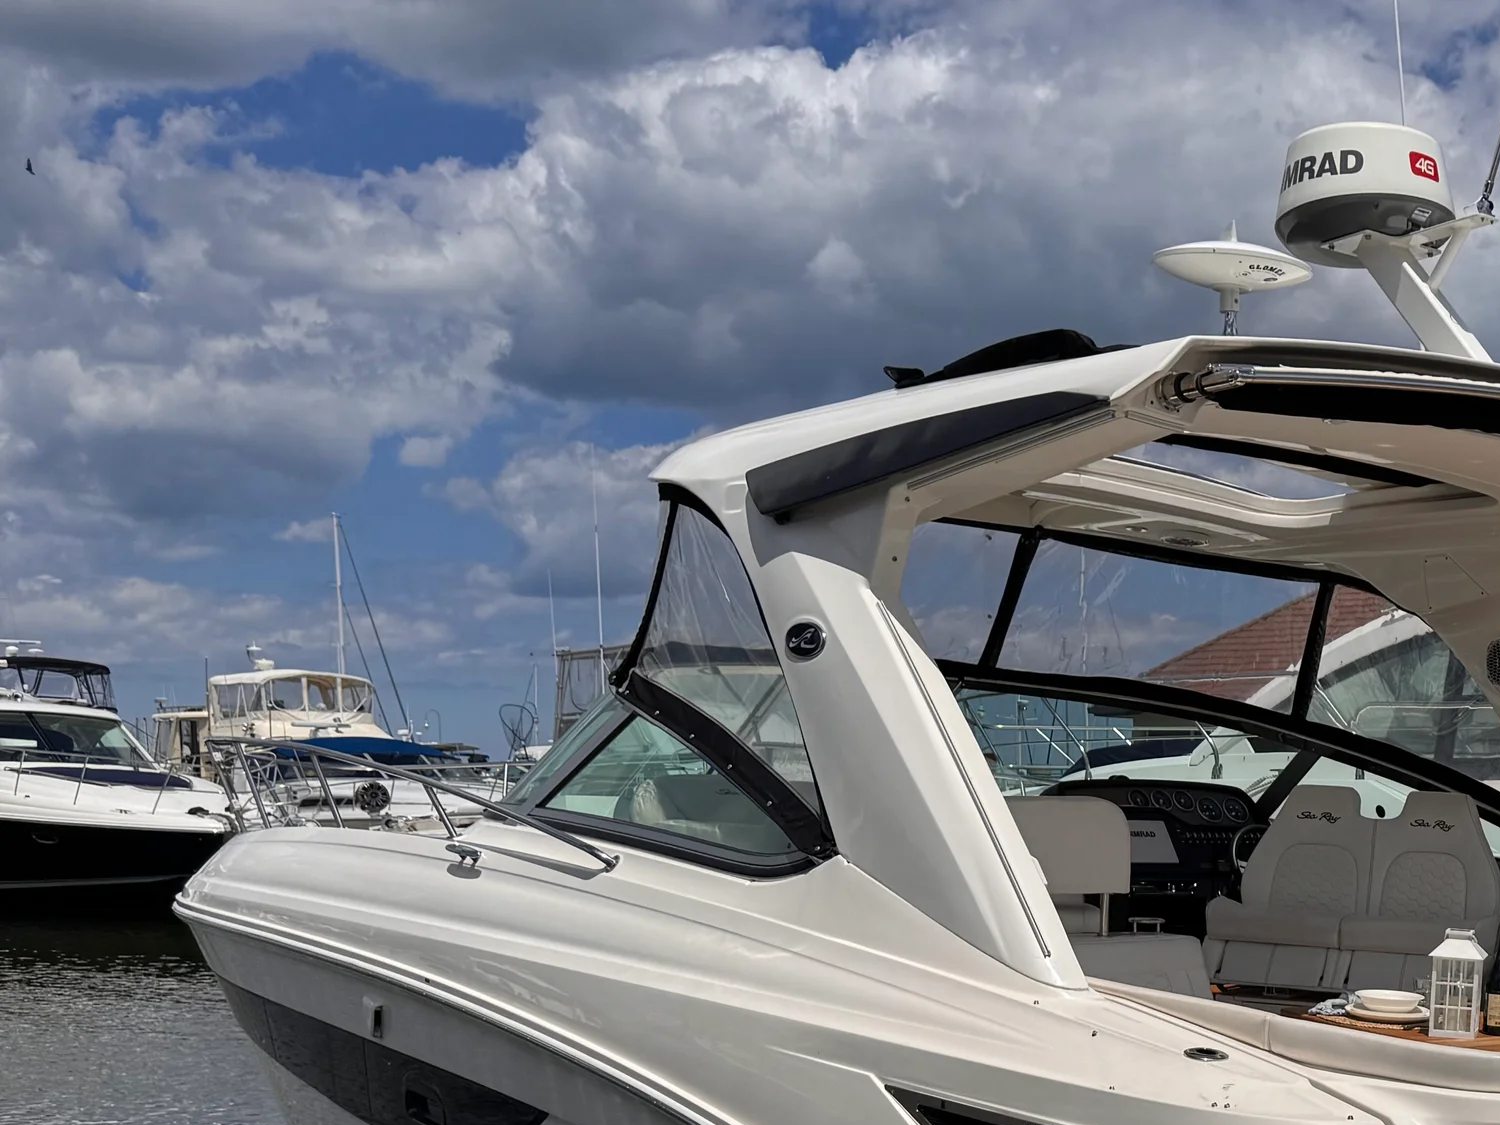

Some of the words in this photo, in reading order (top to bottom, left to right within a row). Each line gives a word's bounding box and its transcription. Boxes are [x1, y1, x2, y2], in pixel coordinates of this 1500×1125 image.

[1415, 157, 1435, 176] 4G
[1296, 810, 1318, 820] Sea
[1319, 811, 1341, 824] Ray
[1409, 818, 1431, 828] Sea
[1432, 819, 1455, 832] Ray
